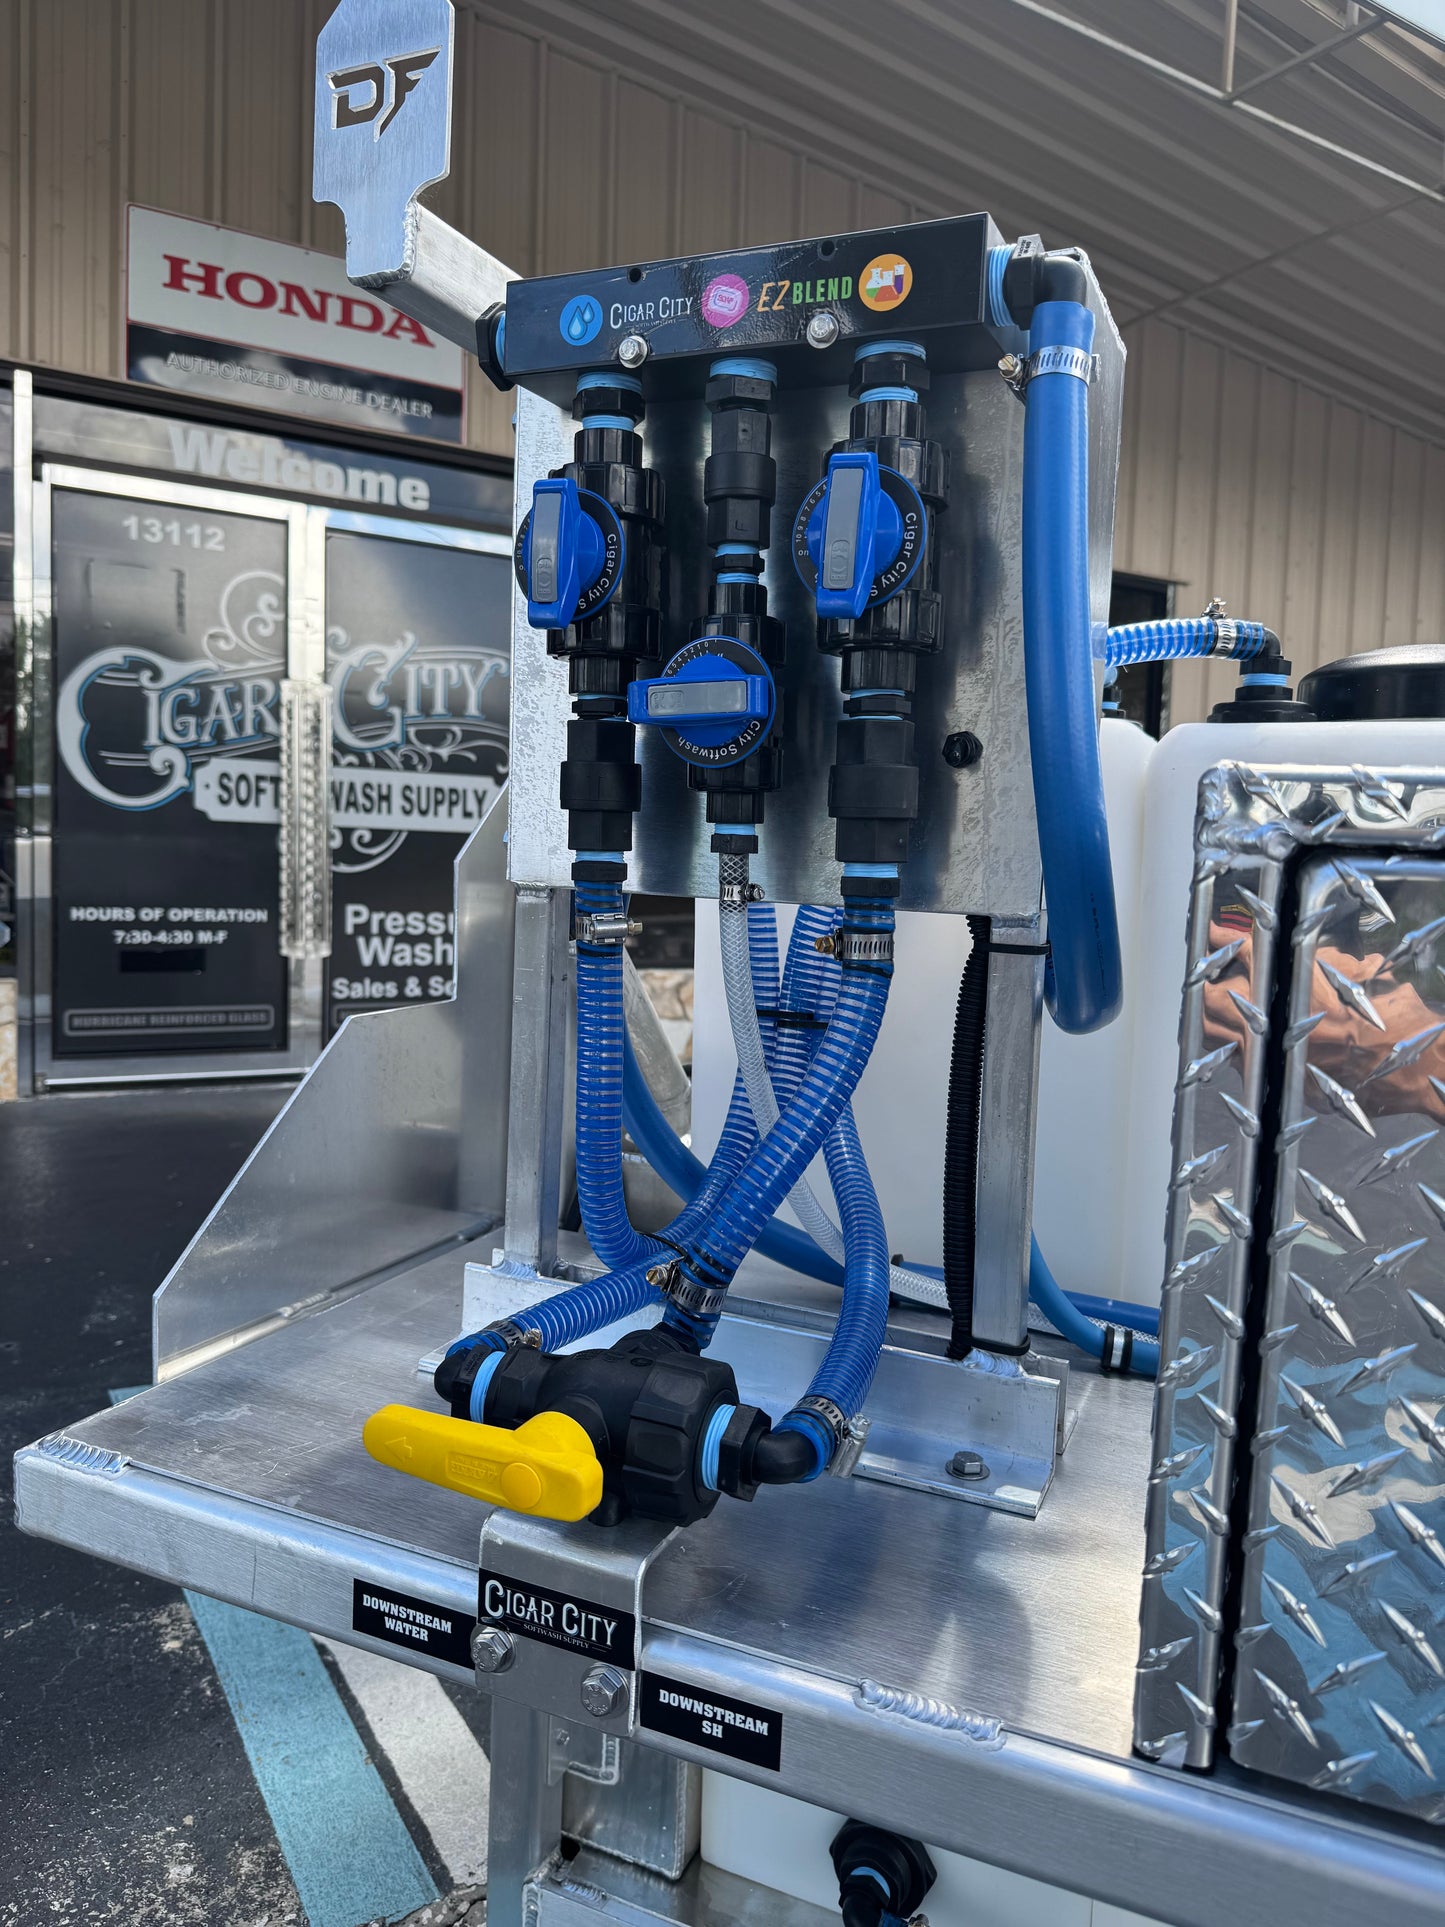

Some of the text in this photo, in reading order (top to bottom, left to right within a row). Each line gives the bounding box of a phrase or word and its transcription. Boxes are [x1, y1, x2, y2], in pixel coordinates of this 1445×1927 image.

[326, 45, 442, 142] DF
[162, 254, 436, 348] HONDA
[792, 276, 852, 304] BLEND
[166, 351, 433, 419] AUTHORIZED ENGINE DEALER
[168, 423, 430, 511] Welcome
[122, 515, 225, 551] 13112
[903, 512, 918, 558] Cigar
[606, 533, 618, 575] Cigar
[588, 577, 610, 602] City
[881, 562, 907, 589] City
[331, 632, 509, 752] CITY
[678, 720, 761, 760] City Softwash
[217, 771, 281, 807] SOFT
[401, 785, 488, 819] SUPPLY
[69, 907, 269, 923] HOURS OF OPERATION
[113, 930, 228, 944] 7:30-4:30 M-F
[332, 977, 399, 999] Sales
[403, 976, 423, 998] &
[362, 1594, 452, 1634] DOWNSTREAM
[384, 1616, 429, 1642] WATER
[485, 1579, 618, 1646] CIGAR CITY
[523, 1623, 590, 1649] SOFTWASH SUPPLY
[659, 1689, 769, 1736] DOWNSTREAM
[701, 1720, 723, 1738] SH
